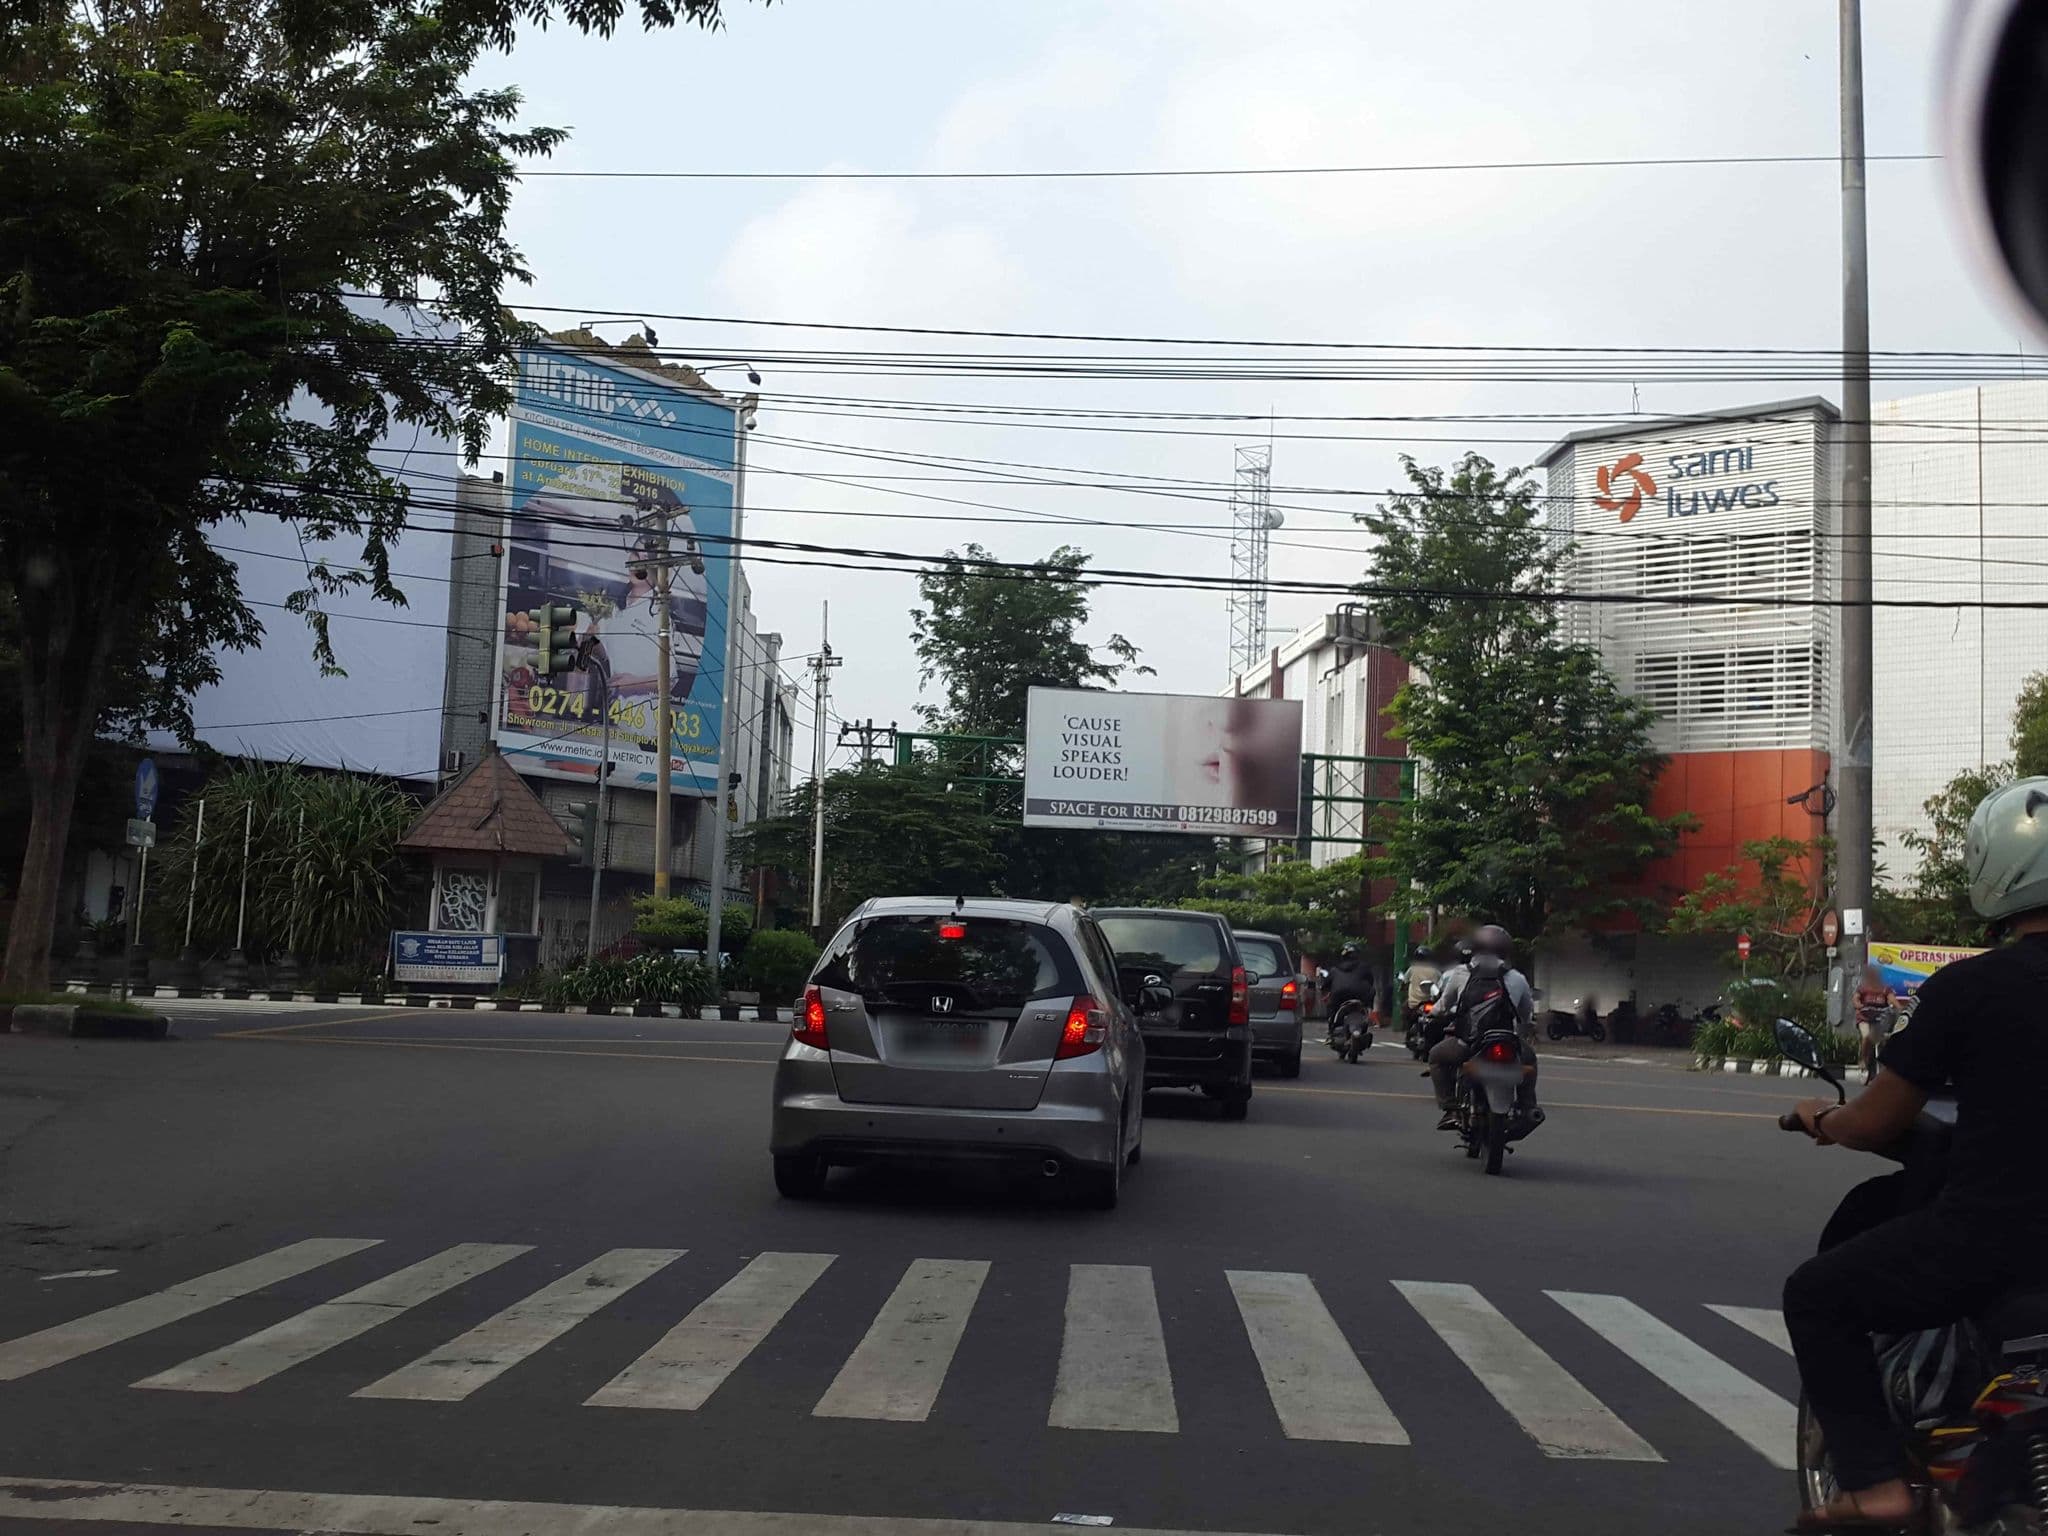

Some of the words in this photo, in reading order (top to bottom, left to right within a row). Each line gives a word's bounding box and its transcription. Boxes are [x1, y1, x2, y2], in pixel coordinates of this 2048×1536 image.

[525, 353, 616, 414] METRIC
[636, 440, 676, 462] BEDROOM
[1667, 446, 1752, 479] sami
[523, 437, 560, 456] HOME
[623, 466, 686, 492] EXHIBITION
[632, 483, 658, 499] 2016
[1667, 480, 1780, 518] luwes
[528, 685, 585, 718] 0274
[608, 699, 646, 729] 446
[1061, 732, 1122, 749] VISUAL
[540, 741, 603, 759] www.metric.id
[612, 752, 644, 766] METRIC
[644, 755, 656, 767] TV
[1060, 749, 1121, 765] SPEAKS
[1053, 765, 1129, 782] LOUDER!
[1049, 800, 1096, 817] SPACE
[1132, 805, 1174, 820] RENT
[1177, 805, 1279, 826] 08129887599
[1899, 949, 1946, 964] OPERASI
